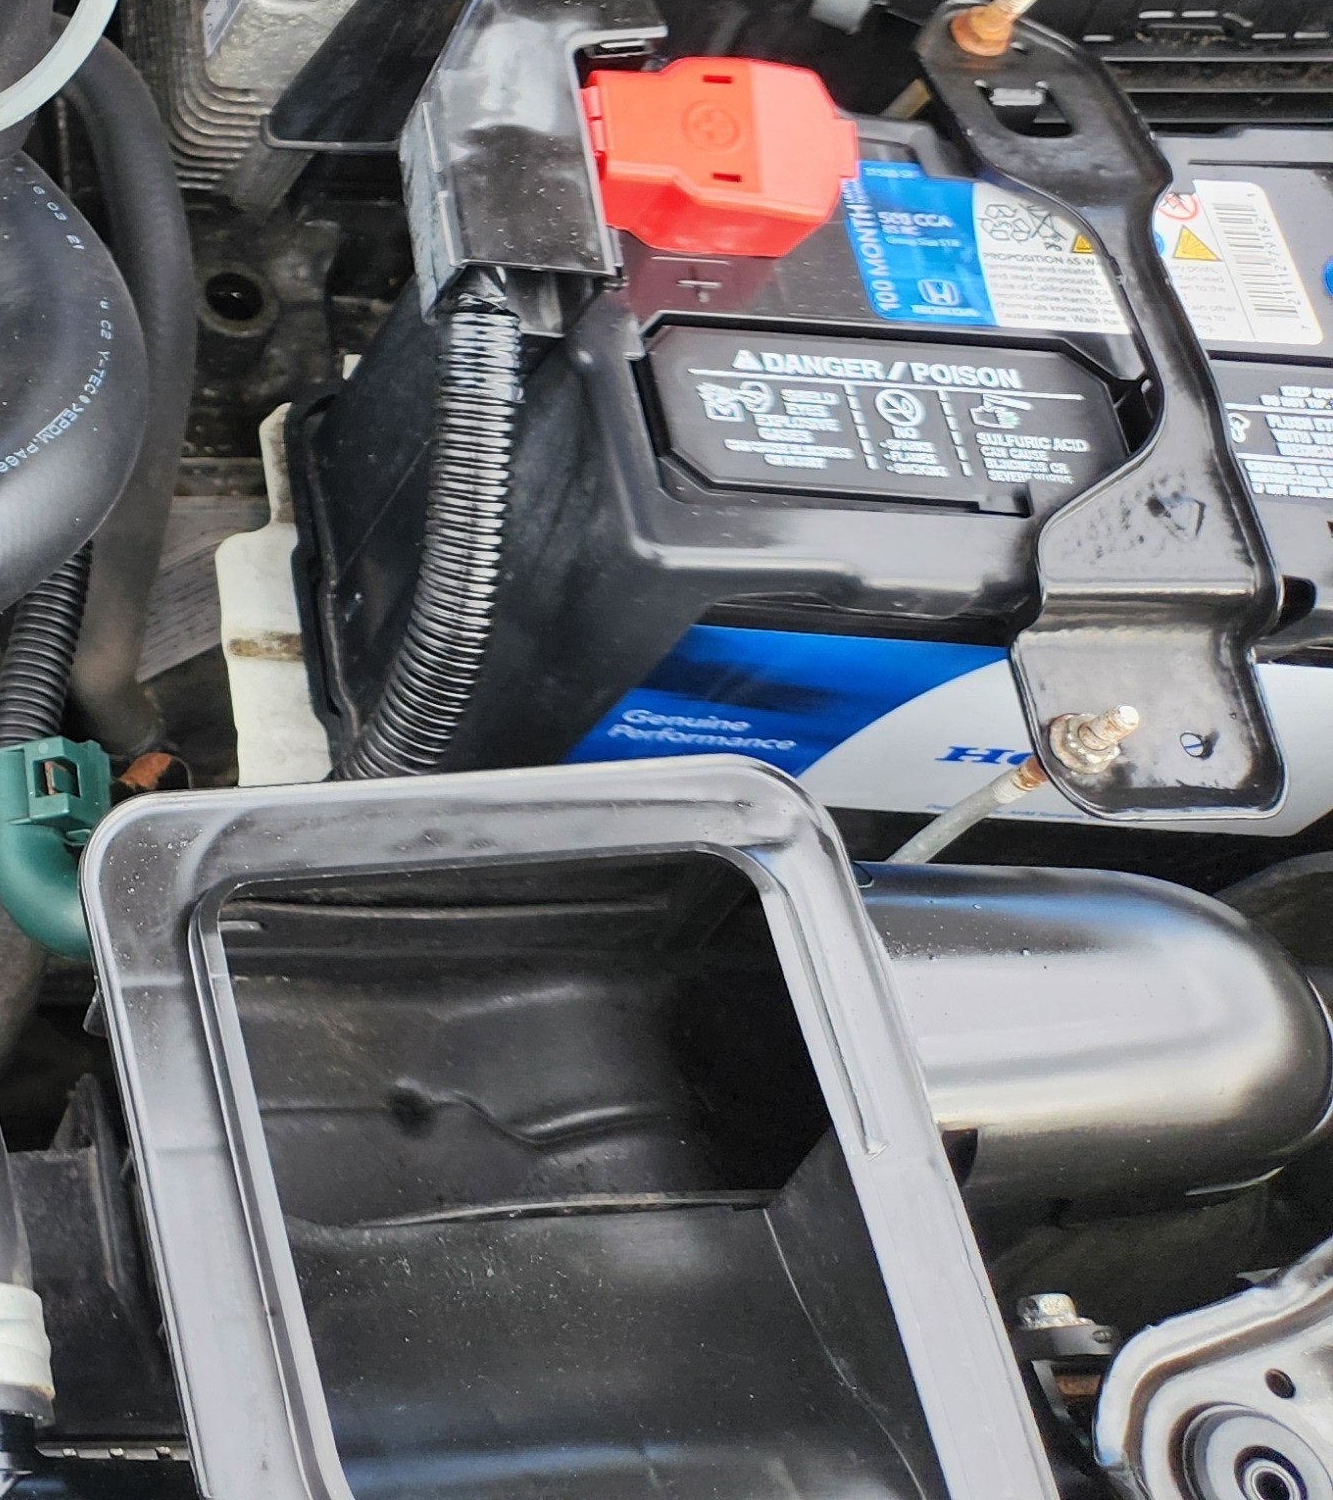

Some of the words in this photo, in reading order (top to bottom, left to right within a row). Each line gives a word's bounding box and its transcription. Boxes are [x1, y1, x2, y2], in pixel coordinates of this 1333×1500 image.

[912, 213, 955, 229] CCA
[844, 203, 892, 277] MONTH
[871, 278, 904, 312] 100
[759, 352, 886, 380] DANGER
[909, 362, 1025, 390] POISON
[976, 432, 1052, 451] SULFURIC
[1052, 437, 1091, 453] ACID
[621, 709, 752, 733] Genuine
[606, 723, 798, 752] Performance
